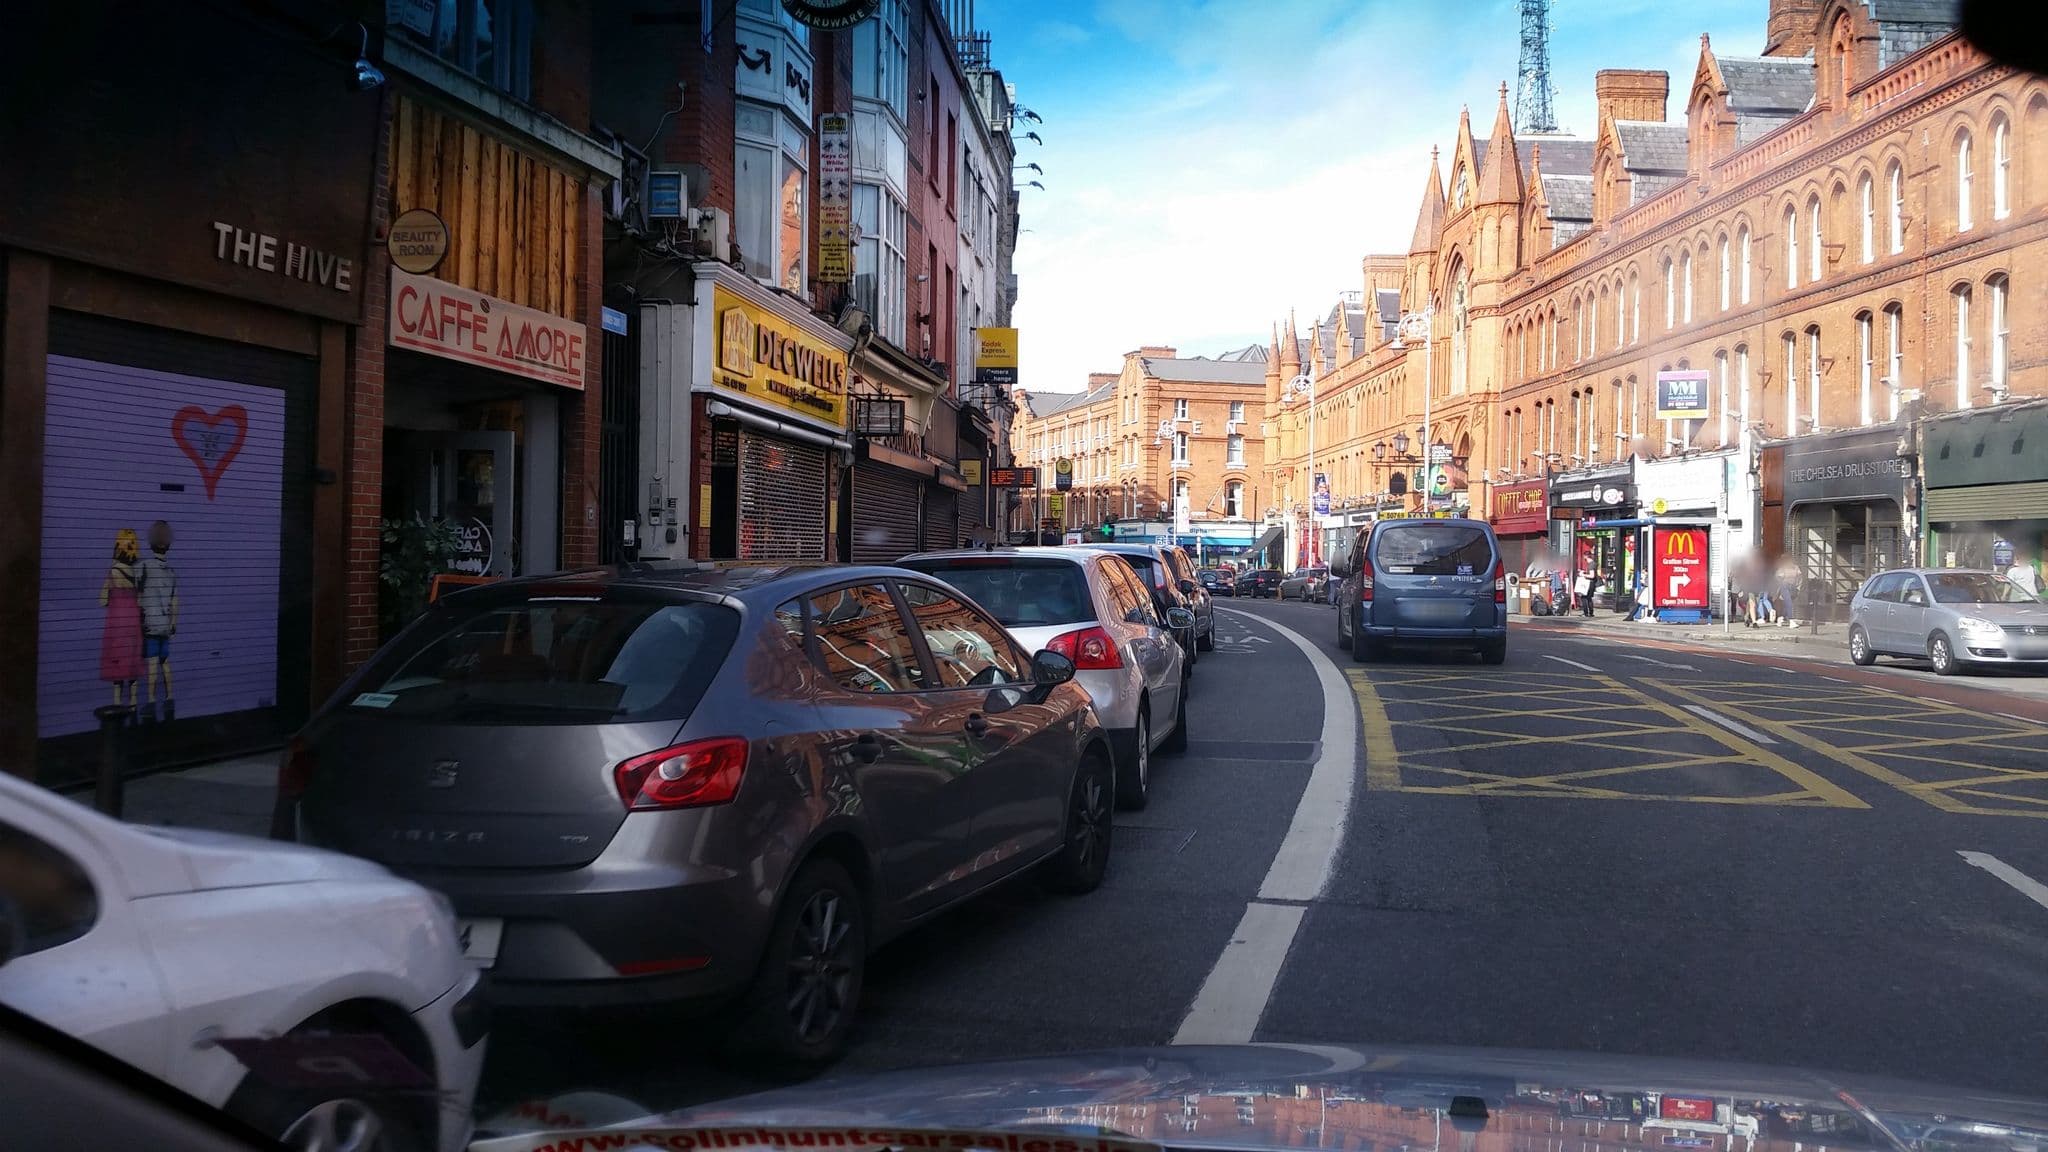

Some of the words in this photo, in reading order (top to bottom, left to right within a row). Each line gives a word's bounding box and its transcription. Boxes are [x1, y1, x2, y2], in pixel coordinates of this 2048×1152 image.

[794, 8, 865, 27] HARDWARE
[392, 230, 441, 243] BEAUTY
[214, 221, 278, 273] THE
[285, 241, 352, 292] HIVE
[399, 244, 436, 256] ROOM
[496, 315, 582, 377] AMORE
[757, 323, 843, 395] DECWELLS
[1790, 469, 1805, 482] THE
[1806, 465, 1843, 481] CHELSEA
[1844, 459, 1901, 477] DRUGSTORE
[1662, 598, 1676, 606] Open
